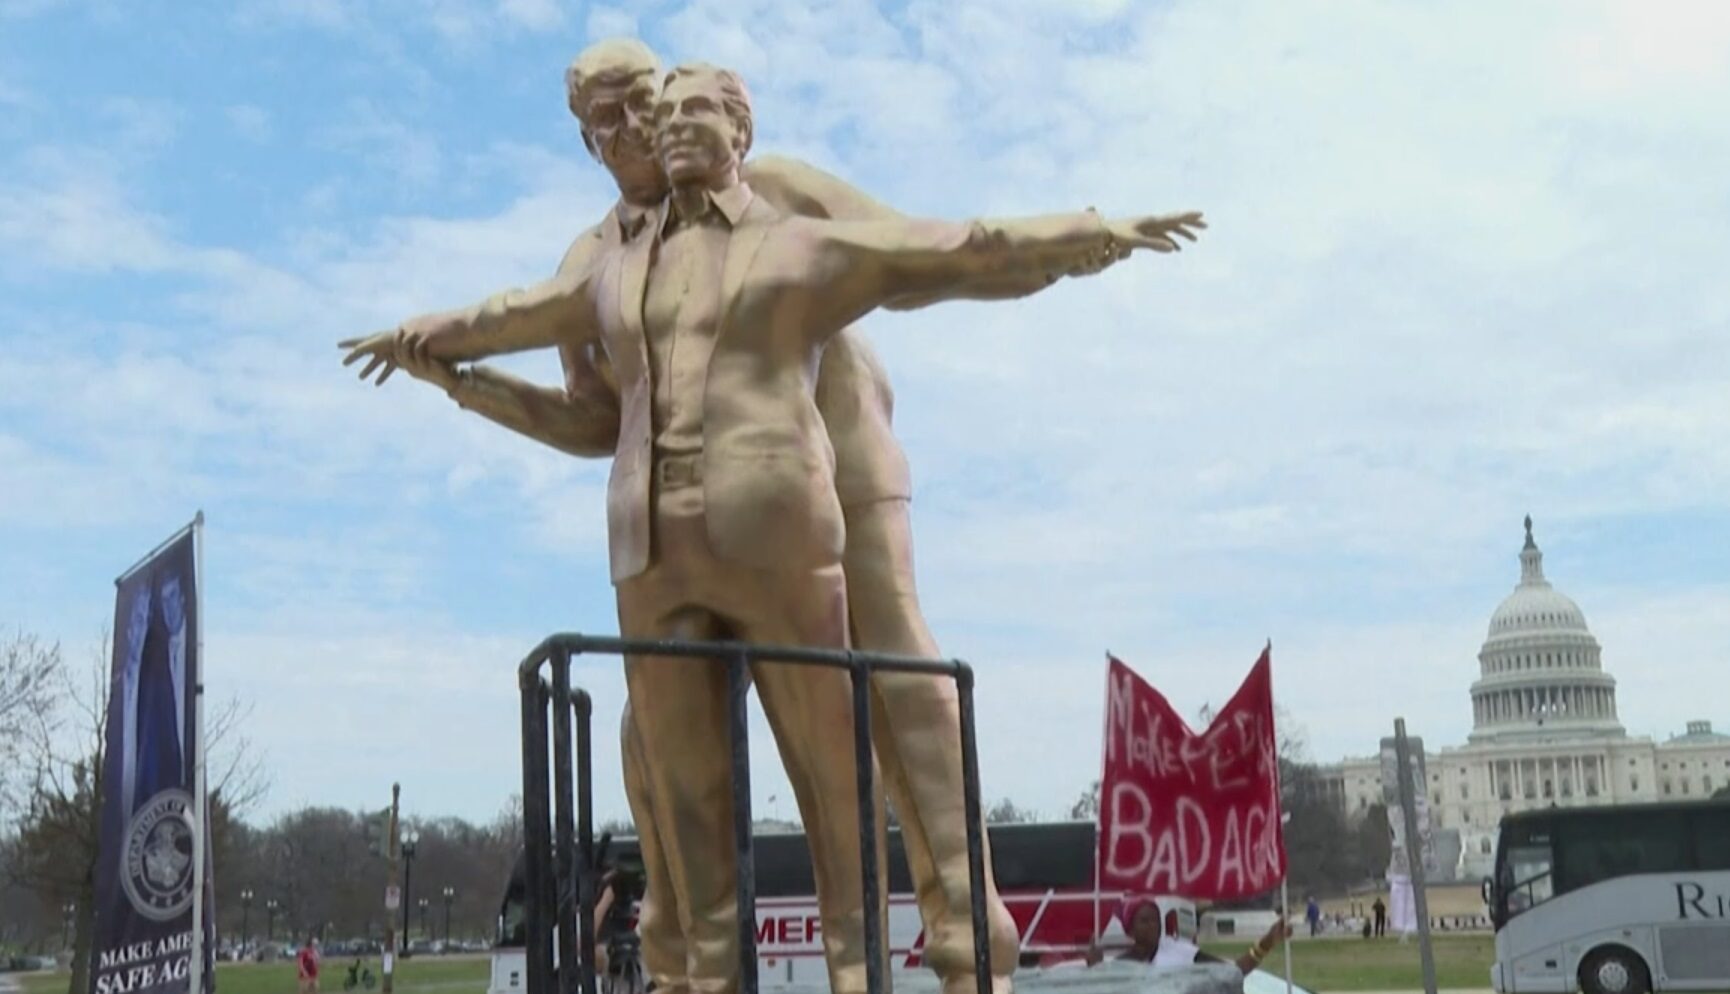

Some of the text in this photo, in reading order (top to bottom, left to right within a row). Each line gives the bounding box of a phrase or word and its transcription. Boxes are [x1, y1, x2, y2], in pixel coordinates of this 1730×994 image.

[1674, 881, 1730, 919] RI
[100, 940, 153, 970] MAKE
[95, 964, 156, 994] SAFE
